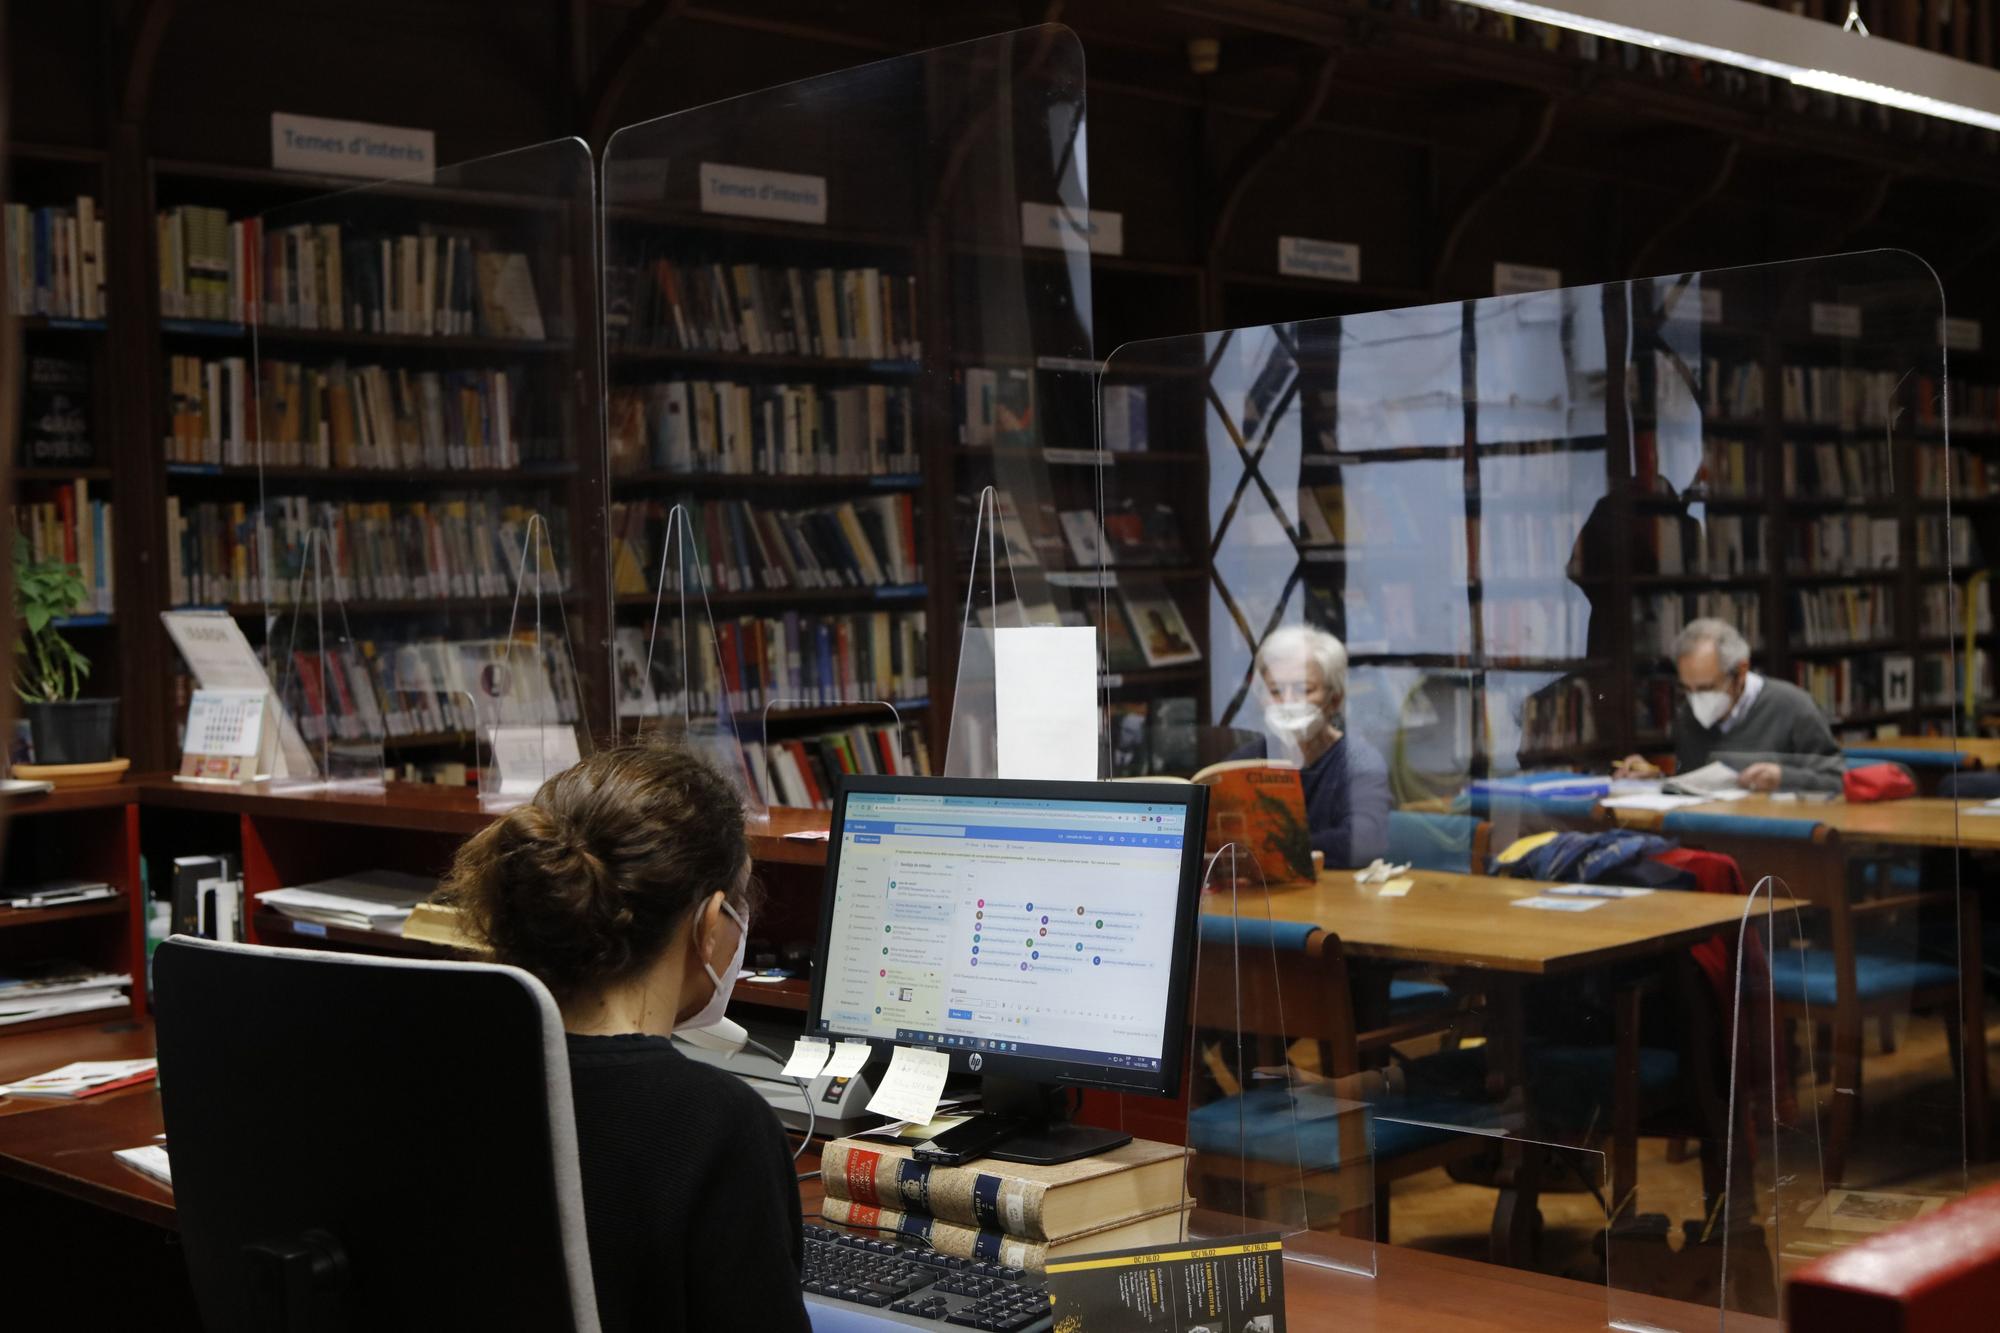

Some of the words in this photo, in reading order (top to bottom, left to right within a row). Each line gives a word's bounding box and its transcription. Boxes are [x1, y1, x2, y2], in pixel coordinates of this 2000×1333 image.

[283, 128, 344, 154] Temes
[349, 136, 424, 161] d'interès
[969, 1054, 983, 1071] hp
